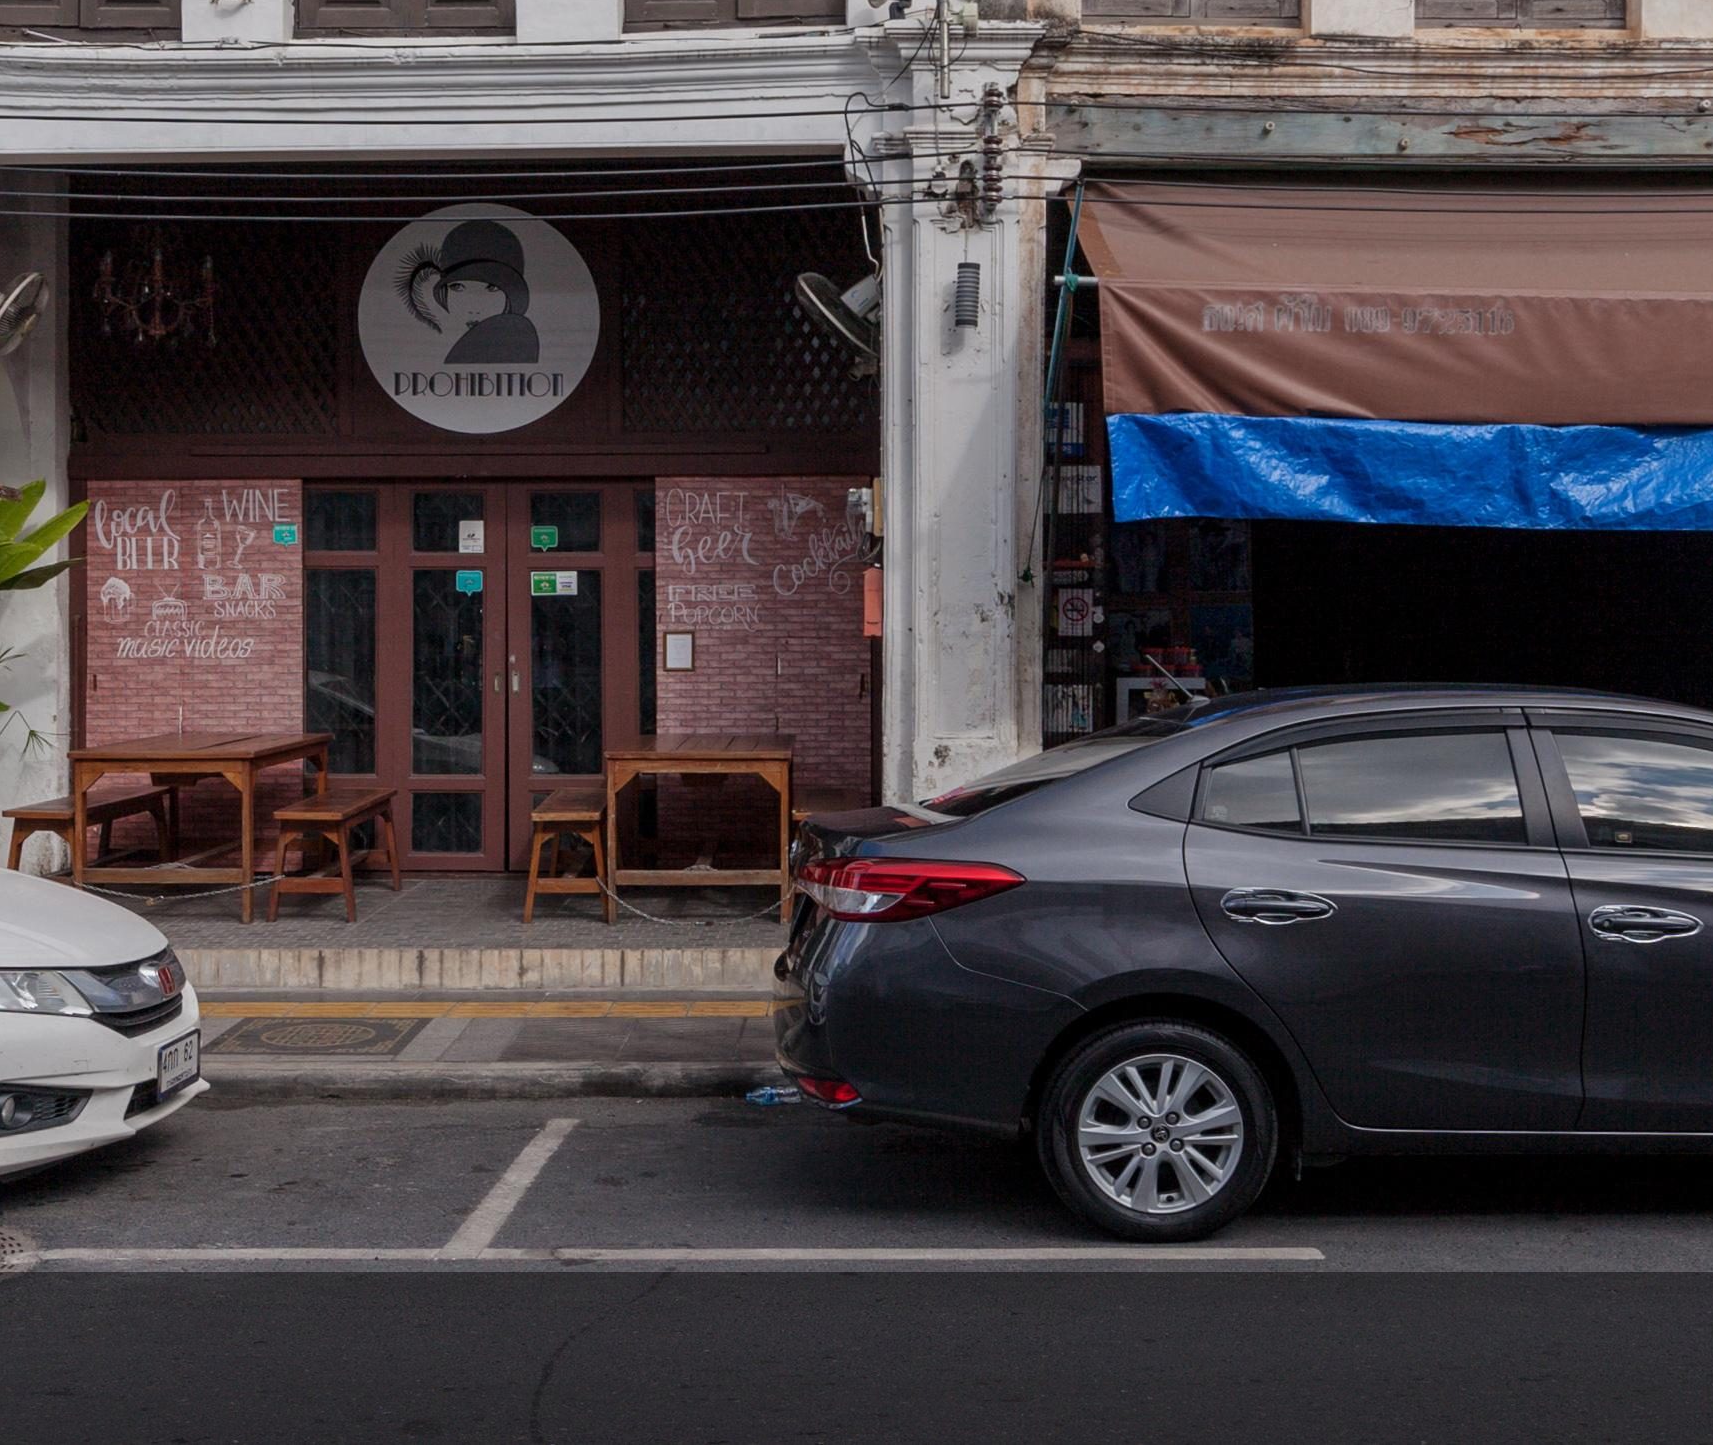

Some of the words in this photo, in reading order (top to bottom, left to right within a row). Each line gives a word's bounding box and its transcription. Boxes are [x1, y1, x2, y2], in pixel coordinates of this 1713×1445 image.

[394, 371, 564, 397] PROHIBITION
[94, 489, 181, 550] local
[222, 489, 292, 523] WINE
[666, 488, 750, 527] CRAFT
[117, 537, 180, 570] BEER
[672, 525, 760, 575] beer
[202, 573, 287, 600] BAR
[667, 584, 758, 602] FREE
[214, 600, 276, 620] SNACKS
[668, 602, 761, 632] POPCORN
[117, 636, 181, 658] music
[183, 625, 254, 658] videos
[144, 620, 206, 637] CLASSIC
